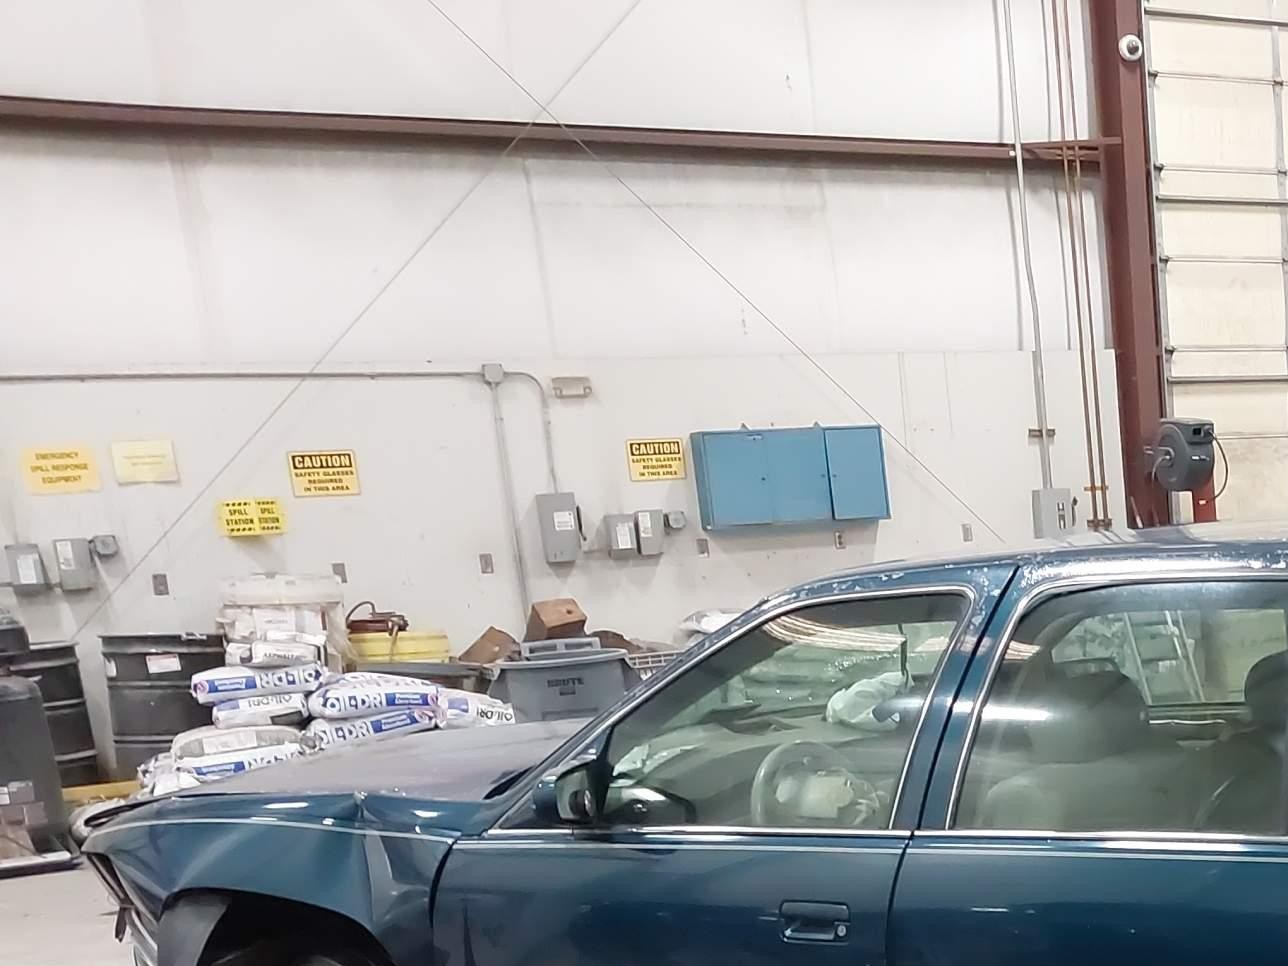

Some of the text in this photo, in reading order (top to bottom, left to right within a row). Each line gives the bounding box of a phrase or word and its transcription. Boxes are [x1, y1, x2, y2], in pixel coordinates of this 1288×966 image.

[631, 442, 679, 455] CAUTION
[35, 452, 79, 460] EMERGENCY
[294, 454, 350, 468] CAUTION
[51, 463, 88, 471] RESPONSE
[42, 475, 81, 484] EQUIPMENT
[228, 508, 248, 516] SPILL
[260, 506, 275, 514] SPILL
[225, 517, 254, 526] STATION
